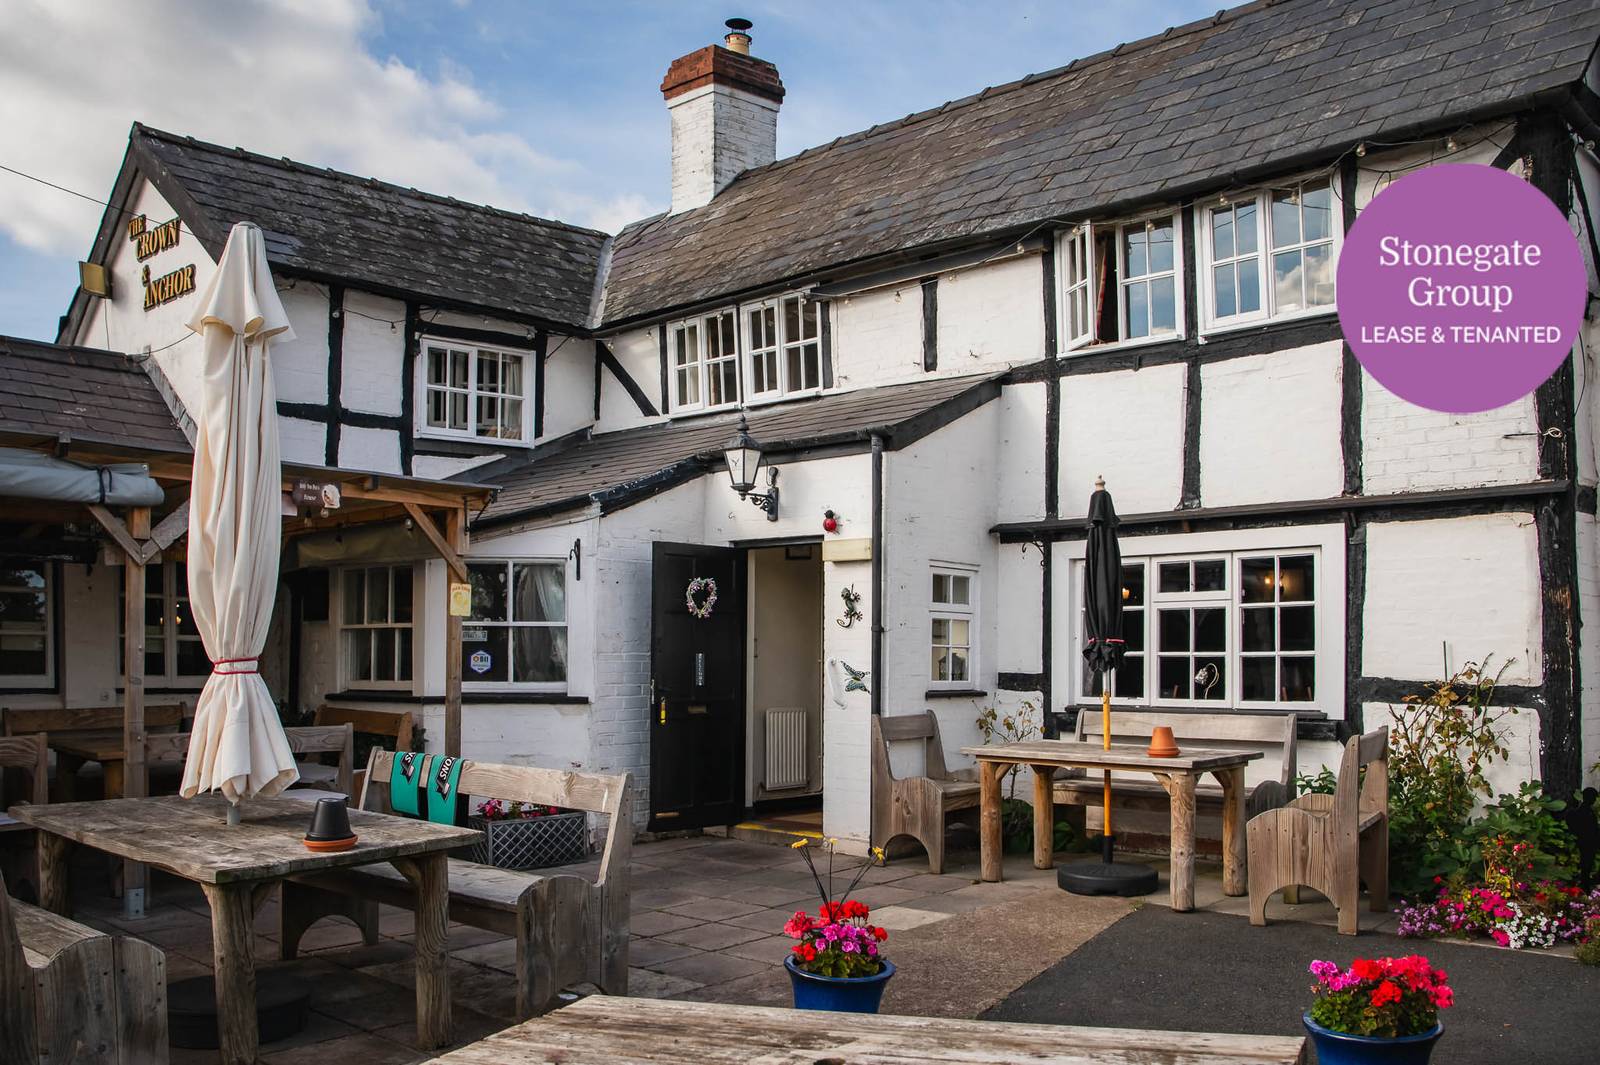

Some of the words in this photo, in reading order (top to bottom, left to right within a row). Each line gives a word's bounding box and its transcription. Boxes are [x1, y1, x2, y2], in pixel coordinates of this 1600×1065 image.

[128, 214, 146, 241] THE
[137, 217, 181, 262] CROWN
[142, 264, 151, 287] &
[144, 264, 196, 312] ANCHOR
